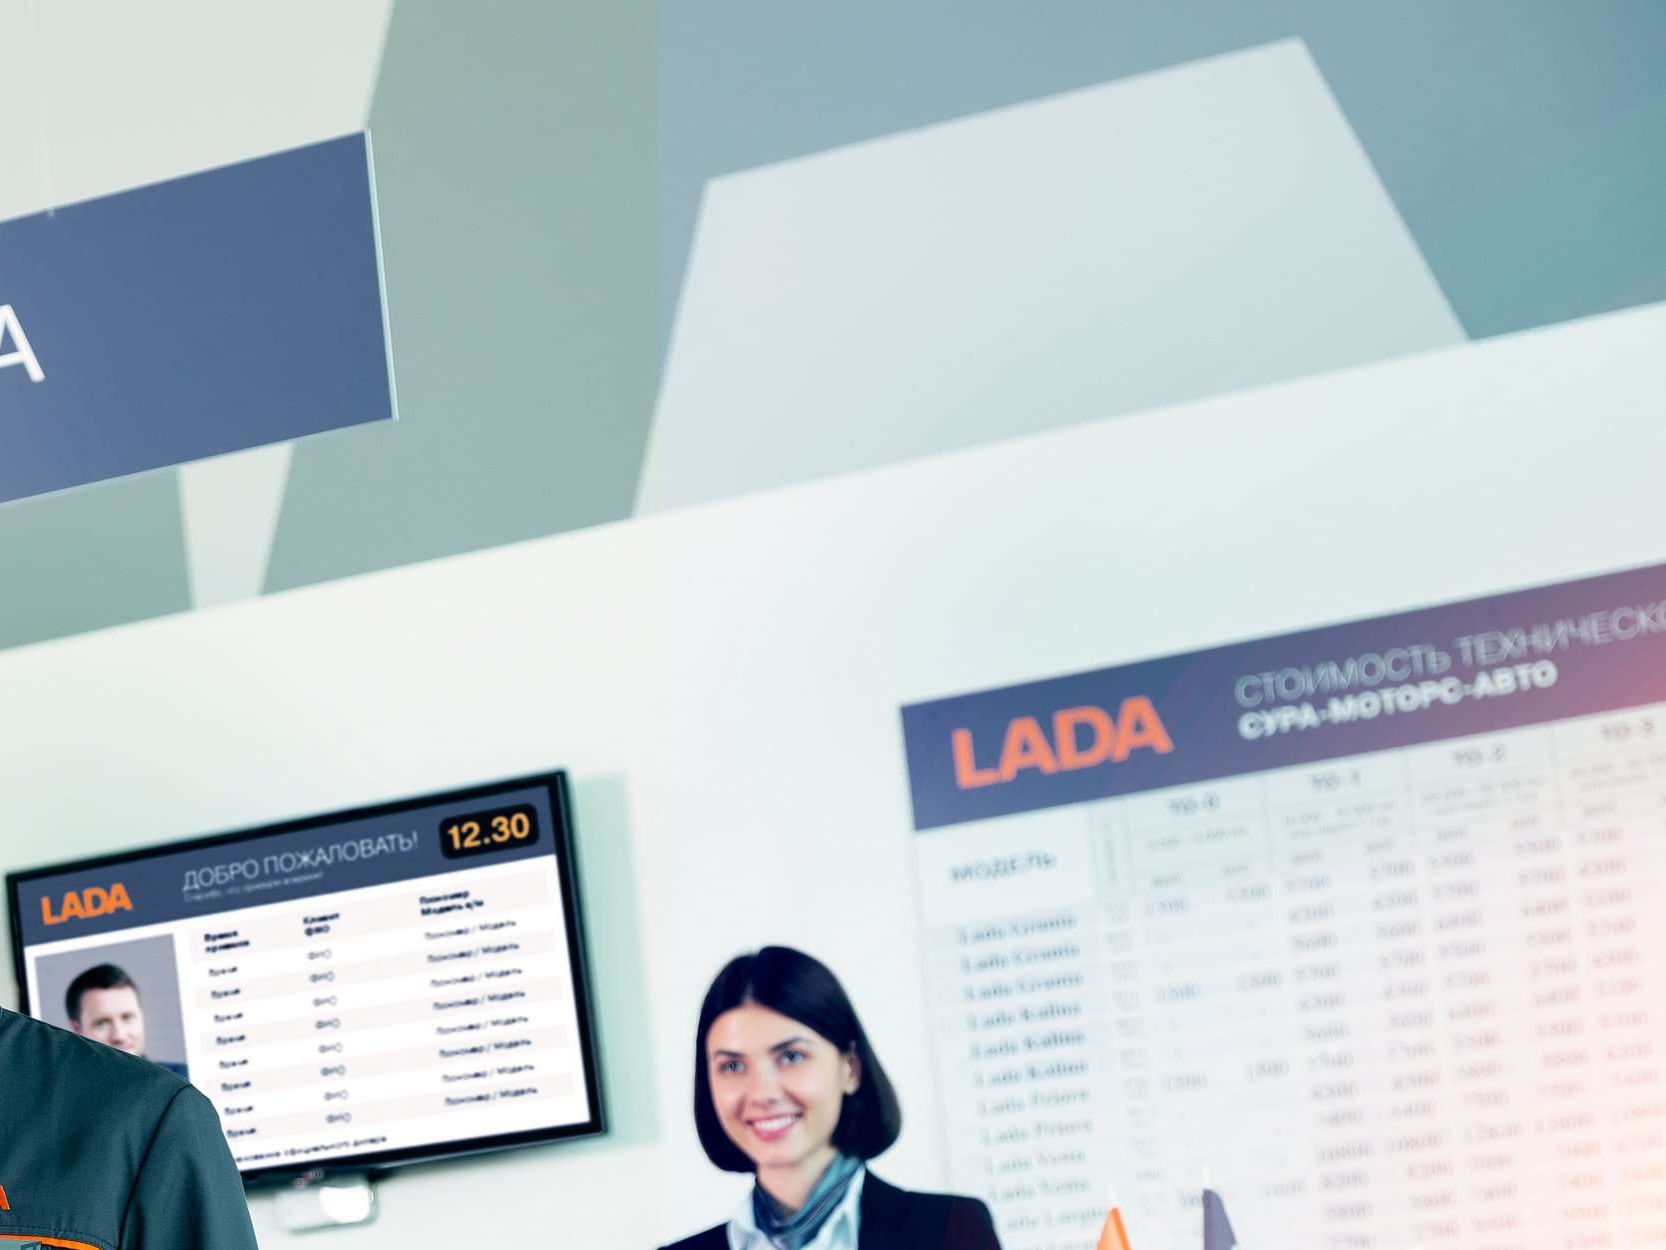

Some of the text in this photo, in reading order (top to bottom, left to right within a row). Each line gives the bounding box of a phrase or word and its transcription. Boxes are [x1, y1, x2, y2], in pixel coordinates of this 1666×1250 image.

[1234, 643, 1452, 709] СТОИМОСТЬ
[1238, 659, 1559, 740] СУРА-МОТОРС-АВТО
[950, 695, 1174, 790] LADA
[182, 830, 418, 893] ДОБРО ПОЖАЛОВАТЬ!
[446, 811, 531, 852] 12.30
[40, 882, 134, 926] LADA
